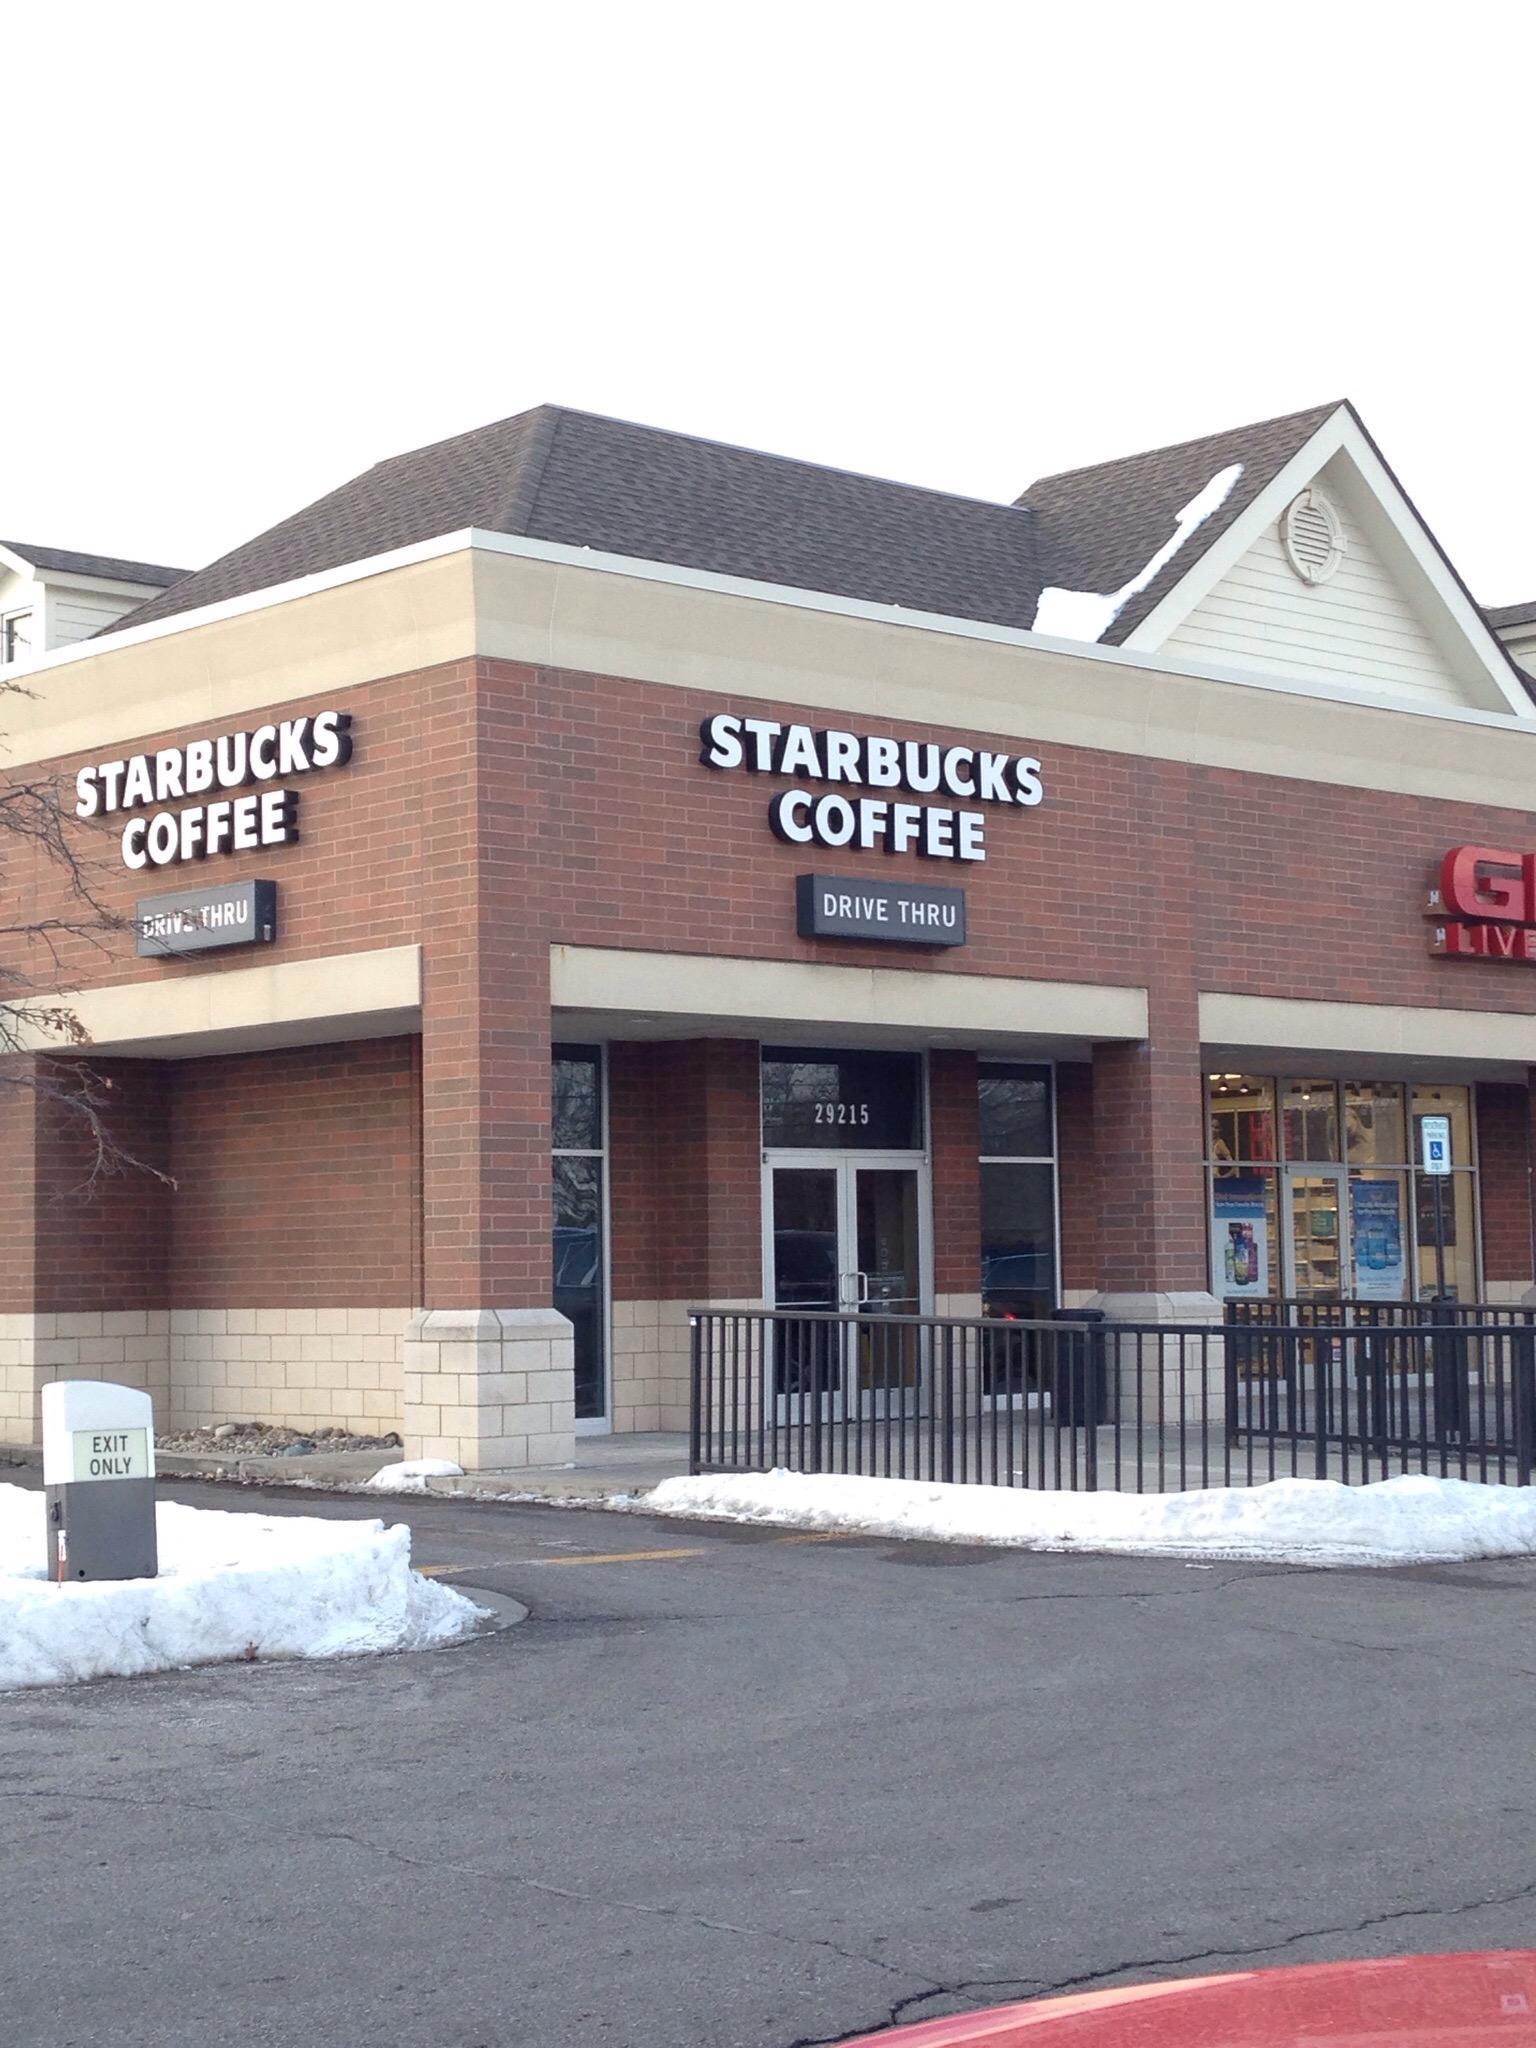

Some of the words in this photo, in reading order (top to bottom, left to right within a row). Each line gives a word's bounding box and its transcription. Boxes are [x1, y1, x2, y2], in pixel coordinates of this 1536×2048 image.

[75, 711, 341, 818] STARBUCKS
[709, 714, 1043, 806] STARBUCKS
[121, 789, 286, 870] COFFEE
[778, 789, 986, 861] COFFEE
[1451, 845, 1536, 921] G
[200, 899, 248, 927] THRU
[823, 893, 889, 922] DRIVE
[897, 900, 956, 928] THRU
[814, 1103, 869, 1125] 29215
[89, 1457, 131, 1476] ONLY
[92, 1435, 128, 1453] EXIT
